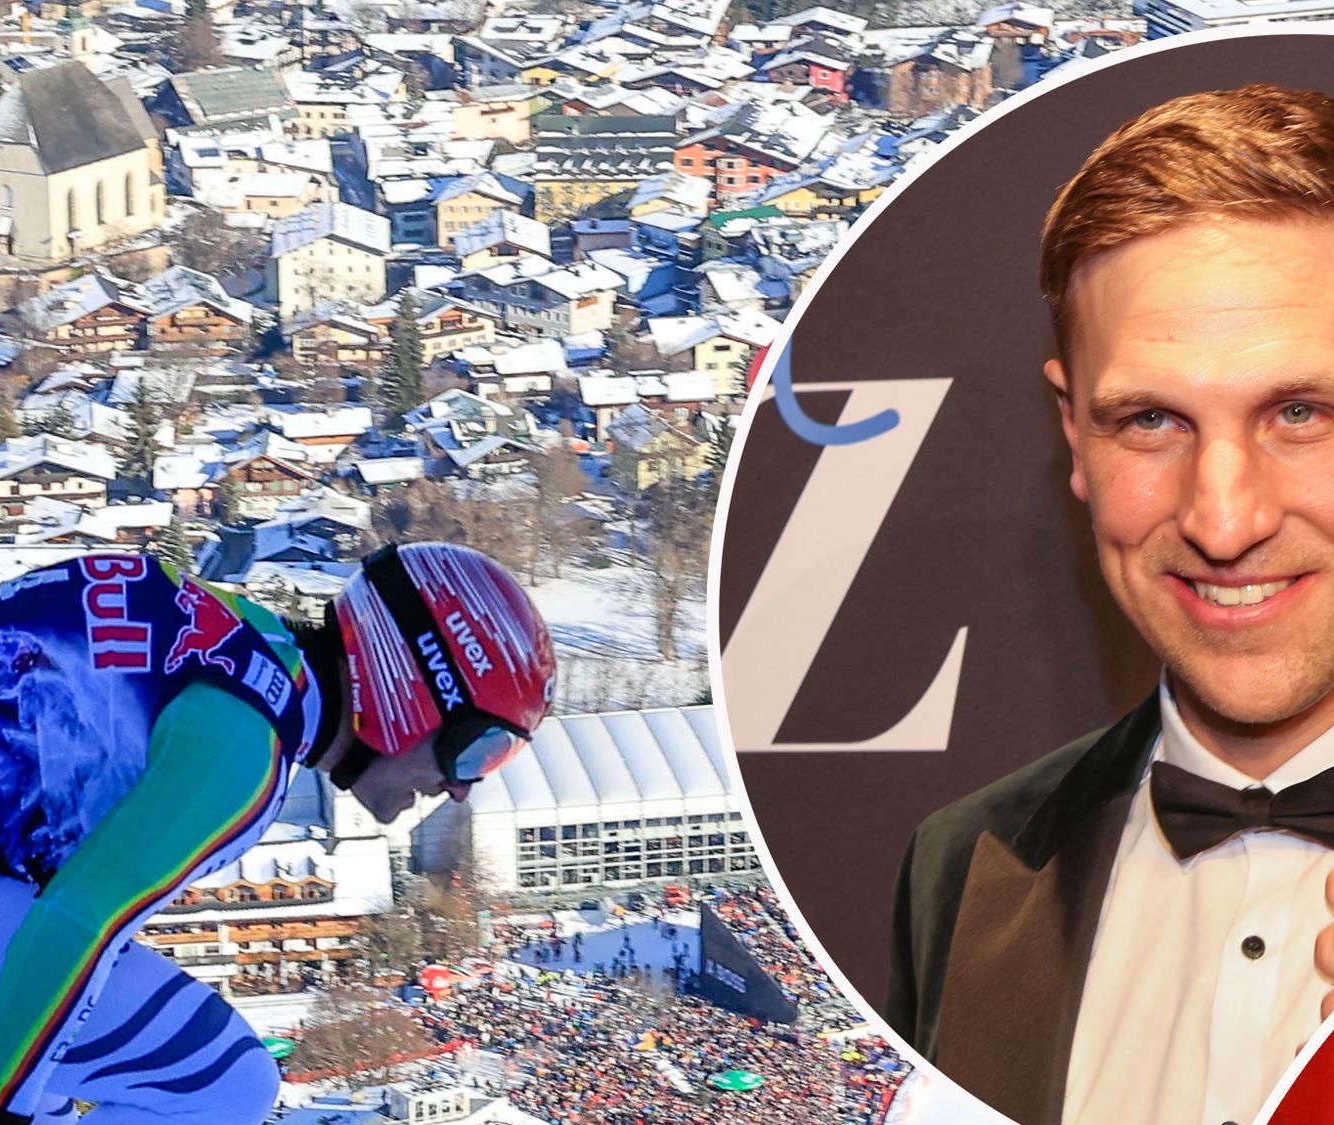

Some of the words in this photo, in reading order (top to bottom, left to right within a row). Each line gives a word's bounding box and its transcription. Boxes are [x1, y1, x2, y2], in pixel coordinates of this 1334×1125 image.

[79, 554, 152, 673] Bull
[445, 610, 493, 677] uvex
[417, 631, 464, 711] uvex
